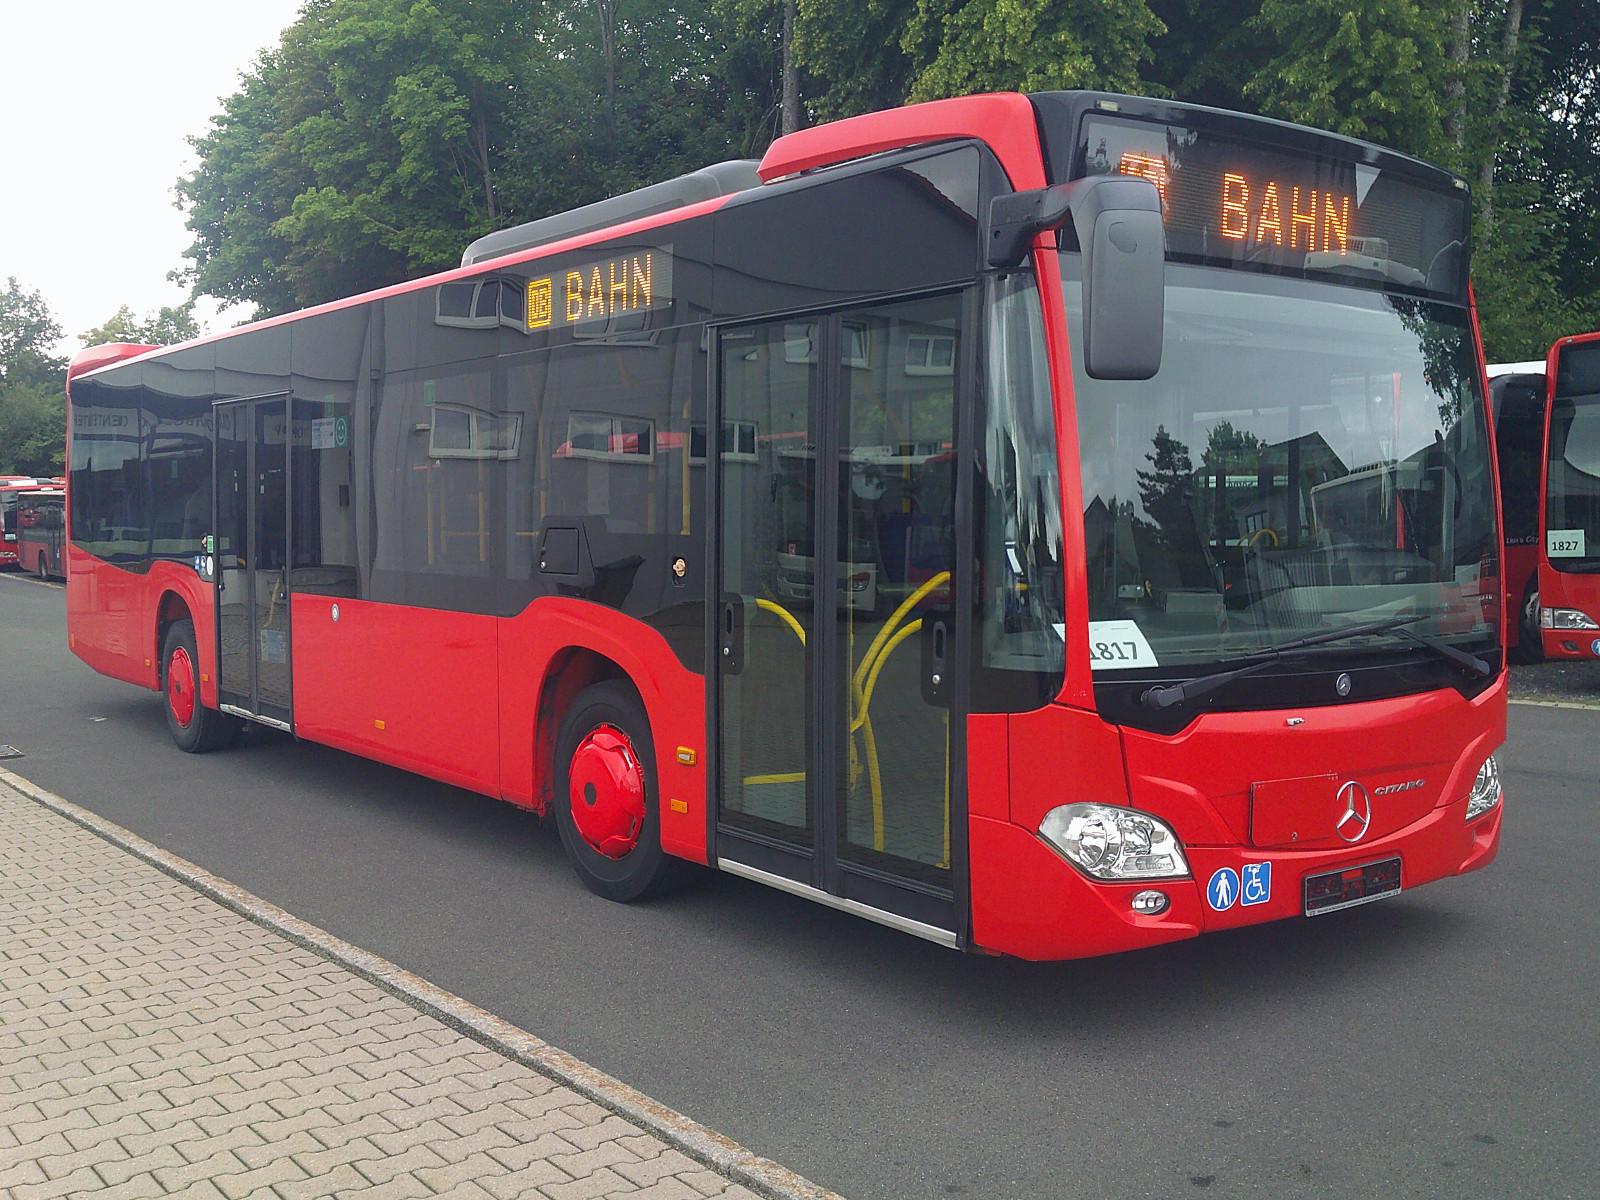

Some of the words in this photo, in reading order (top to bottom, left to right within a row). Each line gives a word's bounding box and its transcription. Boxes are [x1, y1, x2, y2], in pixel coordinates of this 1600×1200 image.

[1222, 172, 1349, 256] BAHN
[566, 253, 652, 322] BAHN
[1551, 541, 1579, 551] 1827
[1374, 779, 1424, 796] CITARO
